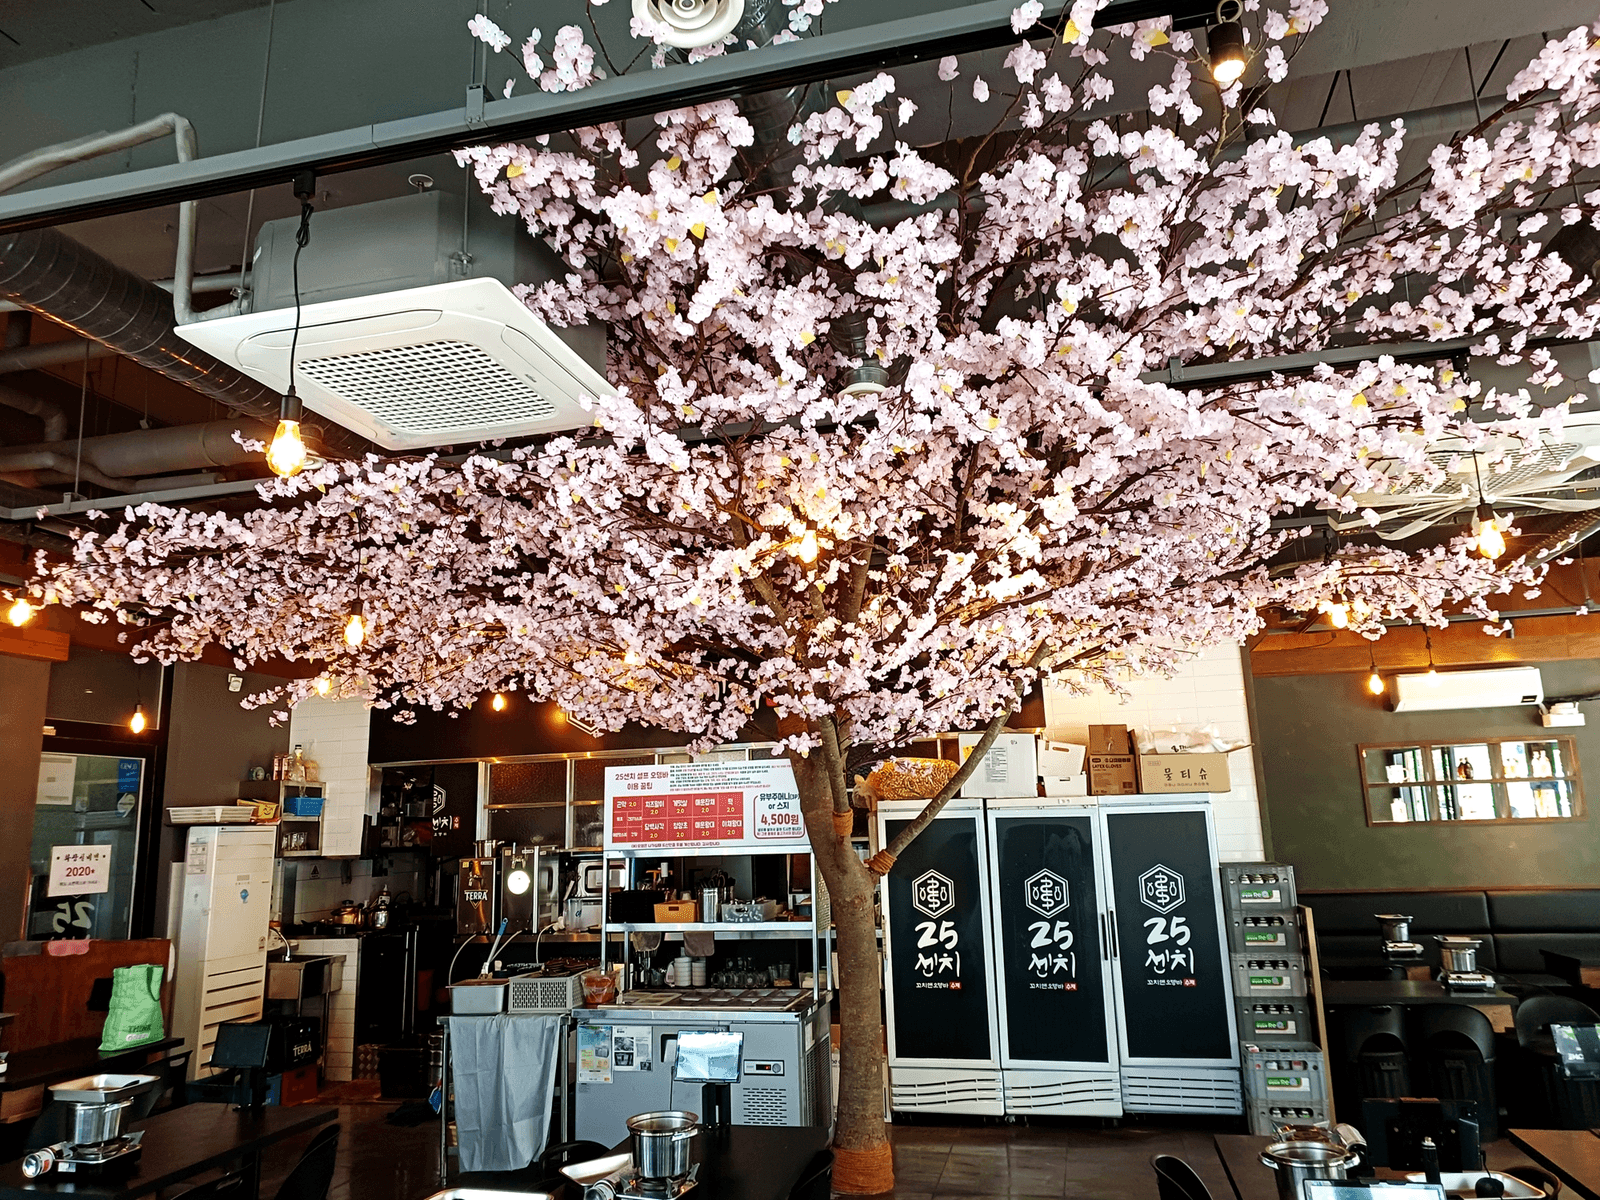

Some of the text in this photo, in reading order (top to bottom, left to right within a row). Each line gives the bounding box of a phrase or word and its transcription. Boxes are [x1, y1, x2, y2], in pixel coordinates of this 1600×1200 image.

[761, 813, 799, 826] 4,500원
[464, 890, 488, 901] TERRA
[915, 920, 958, 950] 25
[1028, 920, 1074, 950] 25
[1144, 916, 1191, 946] 25
[914, 951, 960, 977] 센치
[1028, 951, 1076, 978] 센치
[1145, 947, 1194, 974] 센치
[293, 1040, 312, 1056] TERRA
